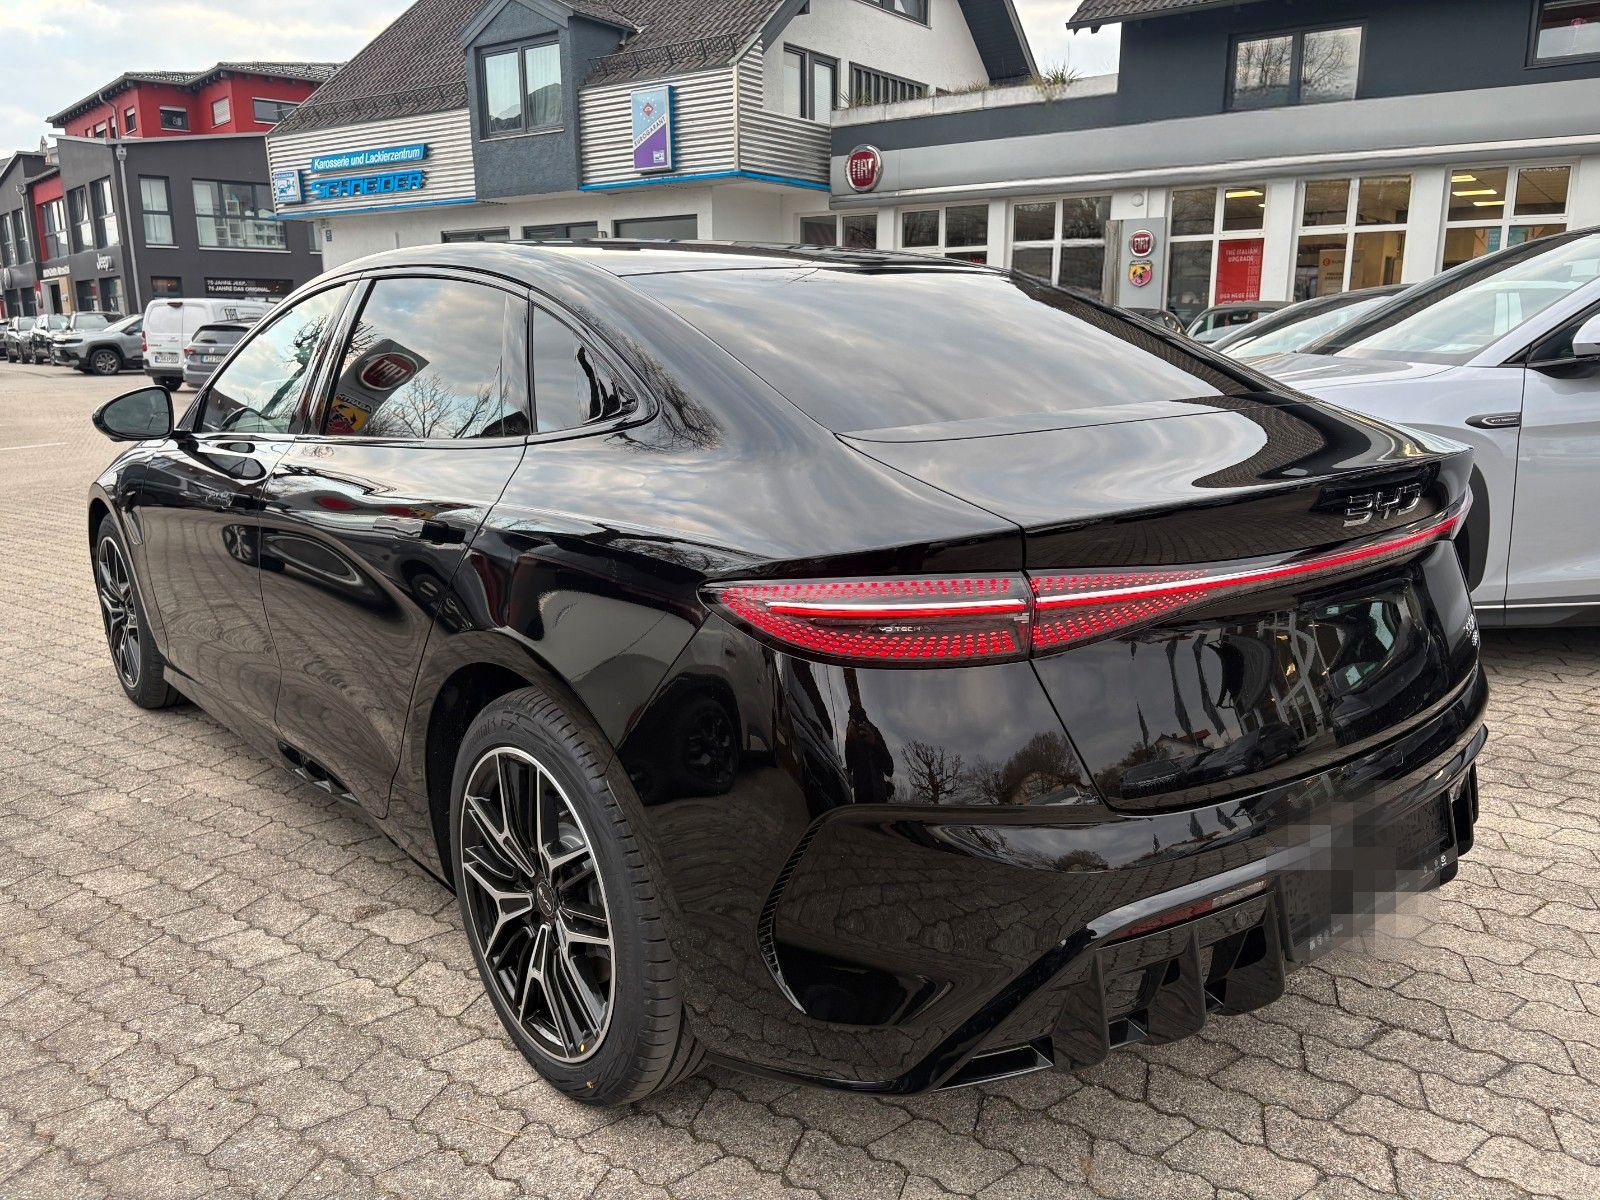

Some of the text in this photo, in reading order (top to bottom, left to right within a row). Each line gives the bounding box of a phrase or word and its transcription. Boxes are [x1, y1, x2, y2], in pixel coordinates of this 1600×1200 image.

[634, 115, 666, 147] EUROGARANT
[314, 148, 420, 170] Karosserie und Lackierzentrum
[852, 158, 874, 179] FIAT
[311, 170, 425, 199] SCHNEIDER
[1134, 237, 1150, 250] FIAT
[1237, 247, 1258, 255] ITALIAN
[96, 253, 112, 272] Jeep
[1343, 482, 1421, 527] BYD
